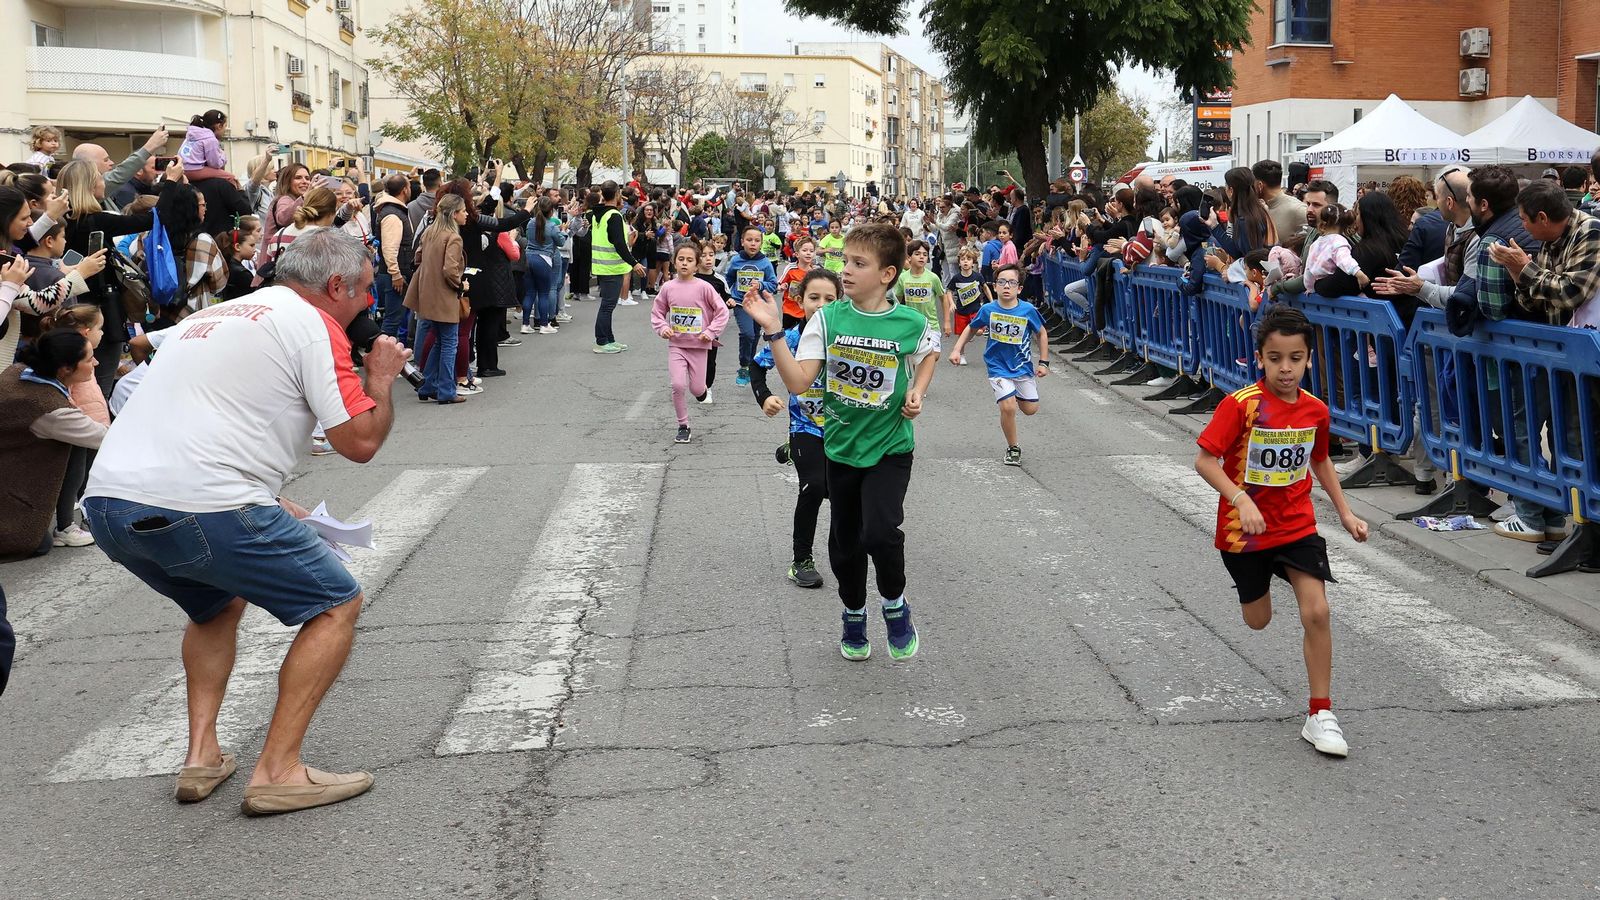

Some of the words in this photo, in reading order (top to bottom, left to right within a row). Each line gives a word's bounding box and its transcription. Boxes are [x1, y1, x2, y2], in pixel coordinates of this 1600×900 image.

[1401, 151, 1458, 161] TIENDA
[908, 288, 928, 297] 809
[674, 314, 696, 326] 677
[995, 322, 1020, 336] 613
[834, 334, 900, 352] MINECRAFT
[839, 351, 864, 363] BOMBEROS
[873, 358, 886, 367] JEREZ
[835, 361, 885, 389] 299
[1263, 437, 1289, 445] BOMBEROS
[1260, 446, 1306, 469] 088
